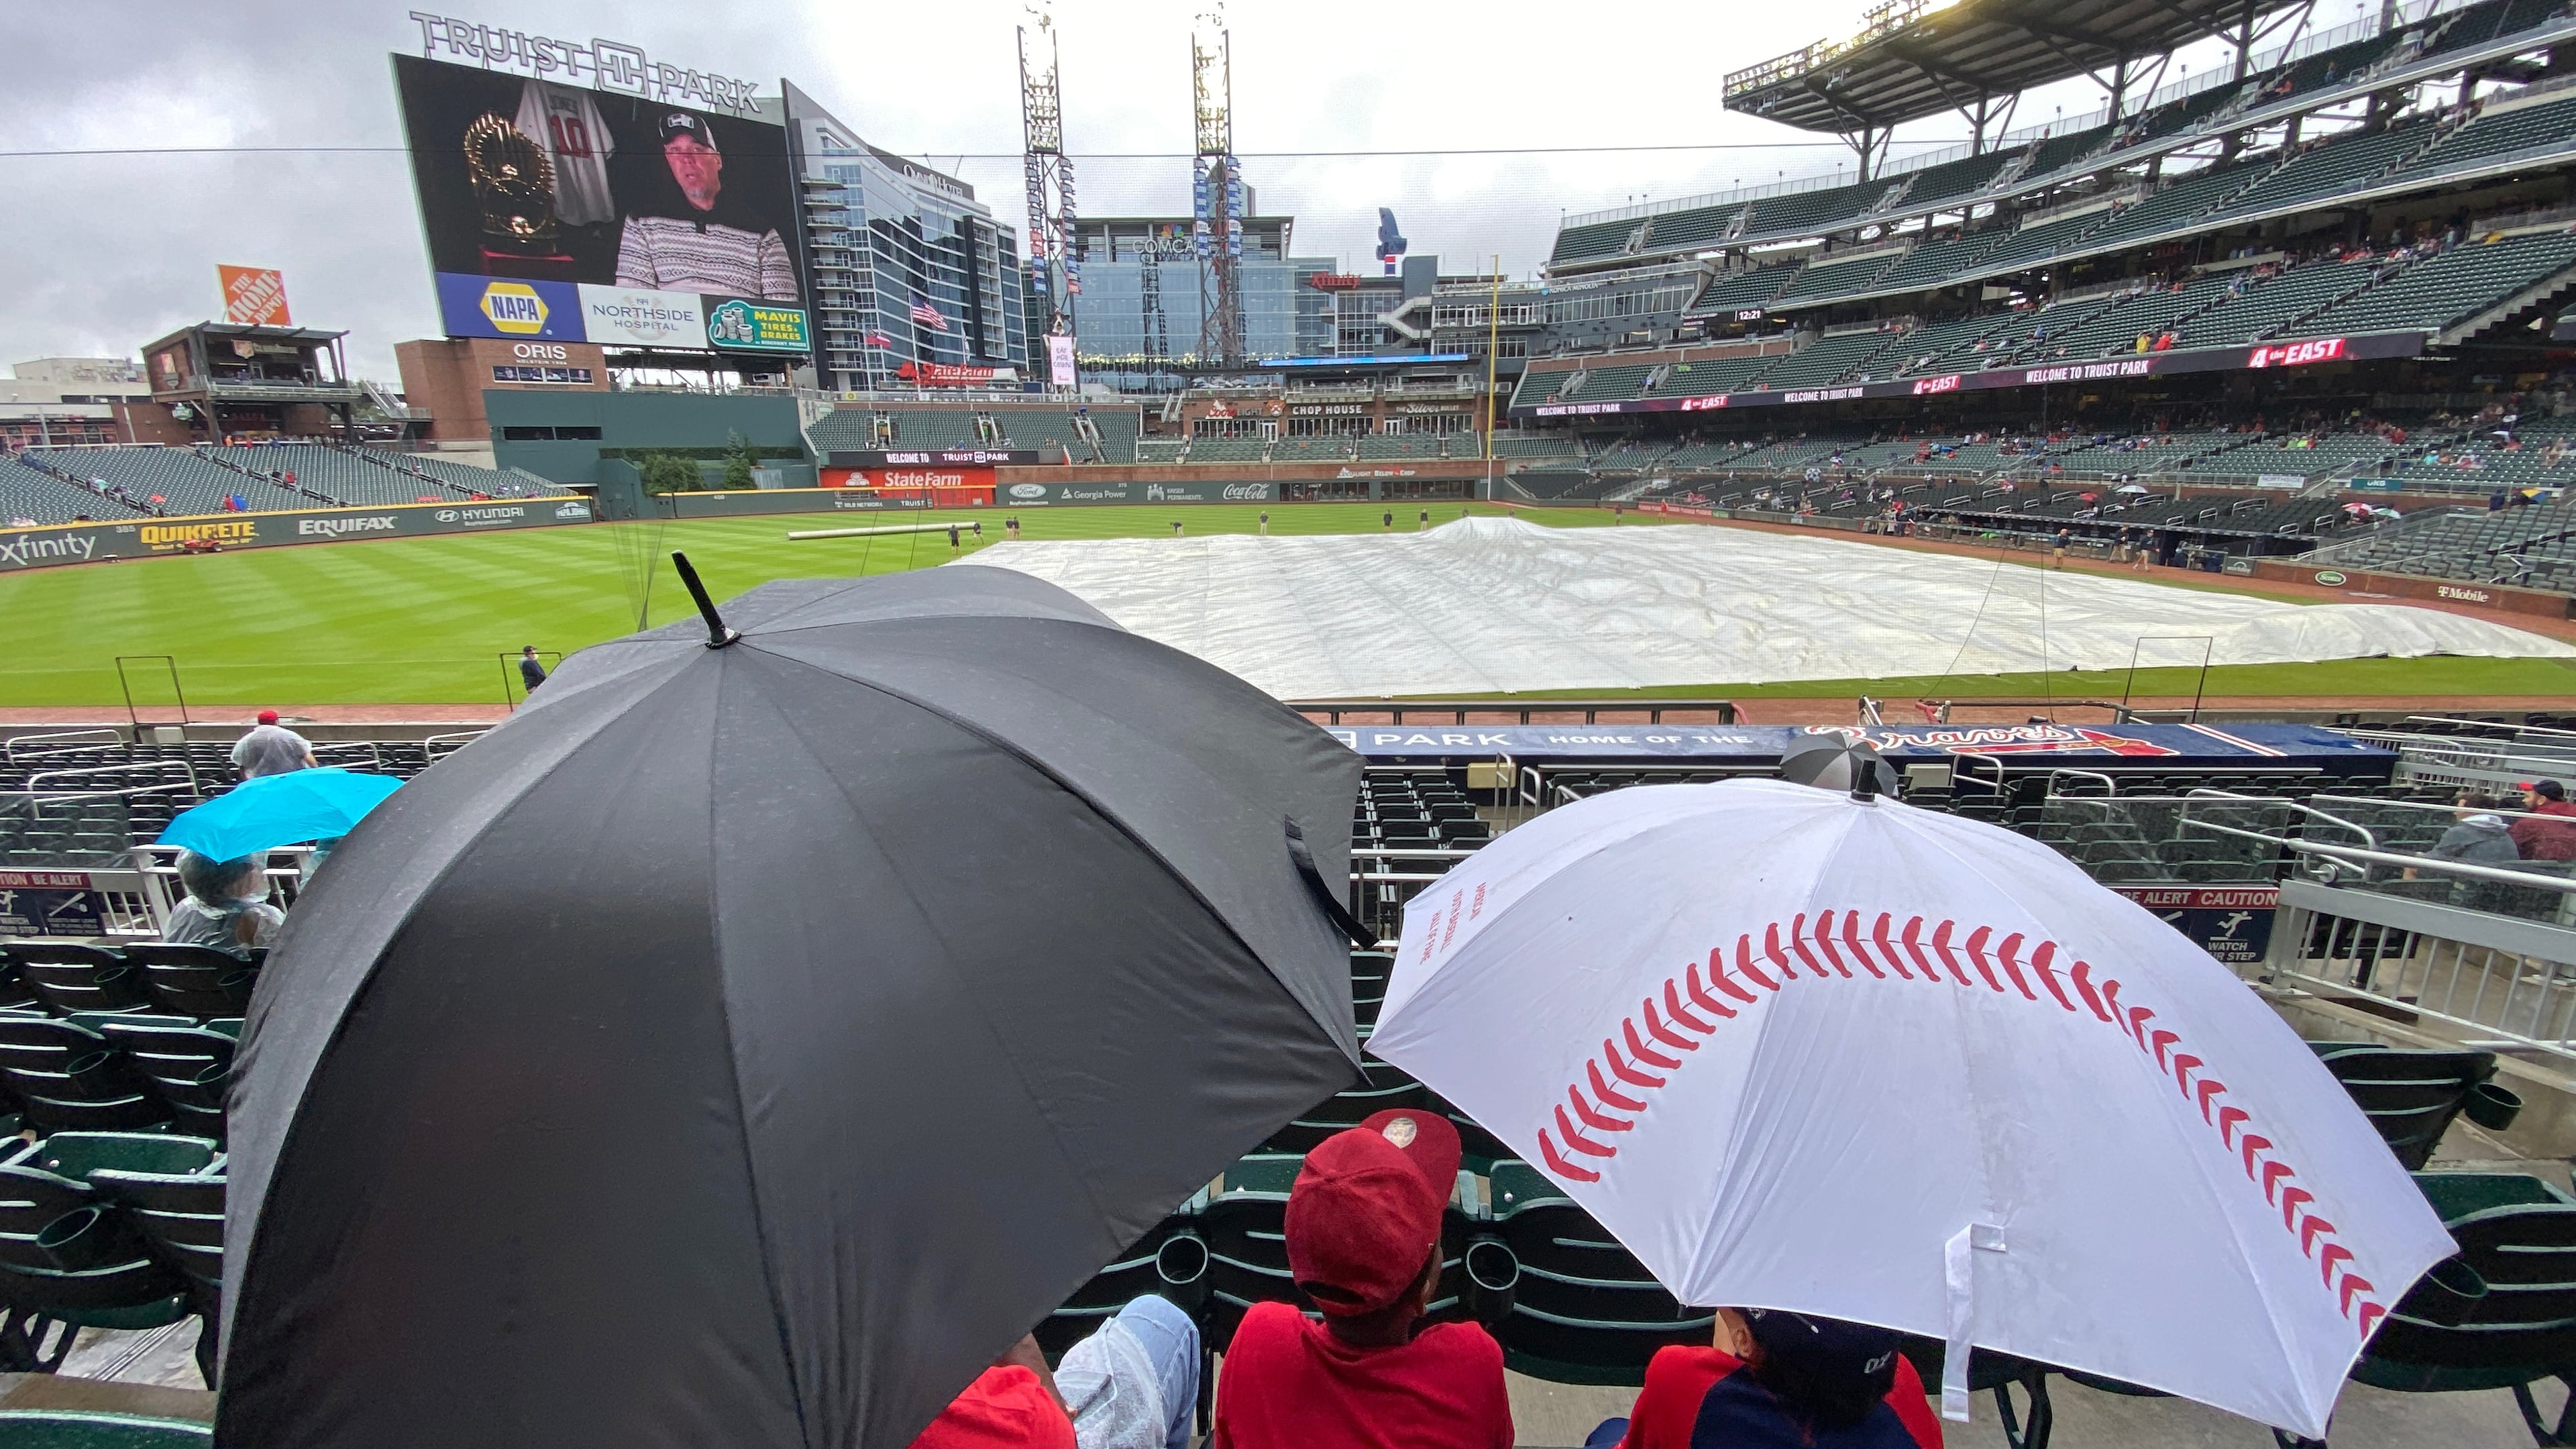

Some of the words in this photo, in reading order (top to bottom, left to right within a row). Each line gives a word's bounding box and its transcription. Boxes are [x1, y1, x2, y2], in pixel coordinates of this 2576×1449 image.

[409, 11, 583, 76] TRUIST
[657, 62, 762, 113] PARK
[549, 114, 592, 158] 10
[229, 273, 253, 294] THE
[227, 270, 282, 323] HOME
[254, 290, 286, 324] DEPOT
[491, 296, 539, 321] NAPA
[592, 305, 694, 322] NORTHSIDE
[754, 311, 801, 323] MAVIS
[1738, 310, 1761, 320] 12:21
[614, 320, 680, 331] HOSPITAL
[760, 323, 793, 332] TIRES
[760, 331, 801, 340] BRAKES
[513, 343, 568, 360] ORIS
[2249, 348, 2267, 368] 4
[2284, 339, 2341, 365] EAST
[2026, 367, 2068, 383] WELCOME
[2070, 366, 2081, 379] TO
[2084, 364, 2118, 378] TRUIST
[2120, 360, 2148, 375] PARK
[1931, 376, 1958, 392] EAST
[1784, 392, 1818, 402] WELCOME
[1820, 390, 1829, 400] TO
[1829, 388, 1847, 399] TRUIST
[1848, 387, 1864, 398] PARK
[1406, 402, 1440, 414] Silver
[1701, 396, 1726, 409] EAST
[1237, 407, 1263, 416] LIGHT
[1292, 405, 1322, 415] CHOP
[1326, 405, 1362, 415] HOUSE
[1536, 406, 1566, 416] WELCOME
[1568, 406, 1576, 415] TO
[1577, 404, 1601, 413] TRUIST
[1601, 403, 1620, 413] PARK
[886, 453, 920, 464] WELCOME
[920, 453, 930, 463] TO
[943, 453, 972, 462] TRUIST
[1017, 486, 1038, 495] Ford
[1074, 490, 1104, 500] Georgia
[1104, 490, 1127, 499] Power
[462, 506, 525, 521] HYUNDAI
[115, 525, 136, 533] 385
[299, 516, 396, 537] EQUIFAX
[0, 532, 96, 566] xfinity
[1373, 733, 1513, 746] PARK
[1548, 735, 1637, 744] HOME
[1645, 735, 1682, 744] OF
[1692, 735, 1754, 744] THE
[1805, 723, 2076, 749] Braves
[32, 874, 49, 885] BE
[50, 875, 83, 885] ALERT
[2144, 892, 2192, 904] ALERT
[2200, 892, 2278, 906] CAUTION
[2208, 941, 2248, 951] WATCH
[2226, 952, 2256, 961] STEP
